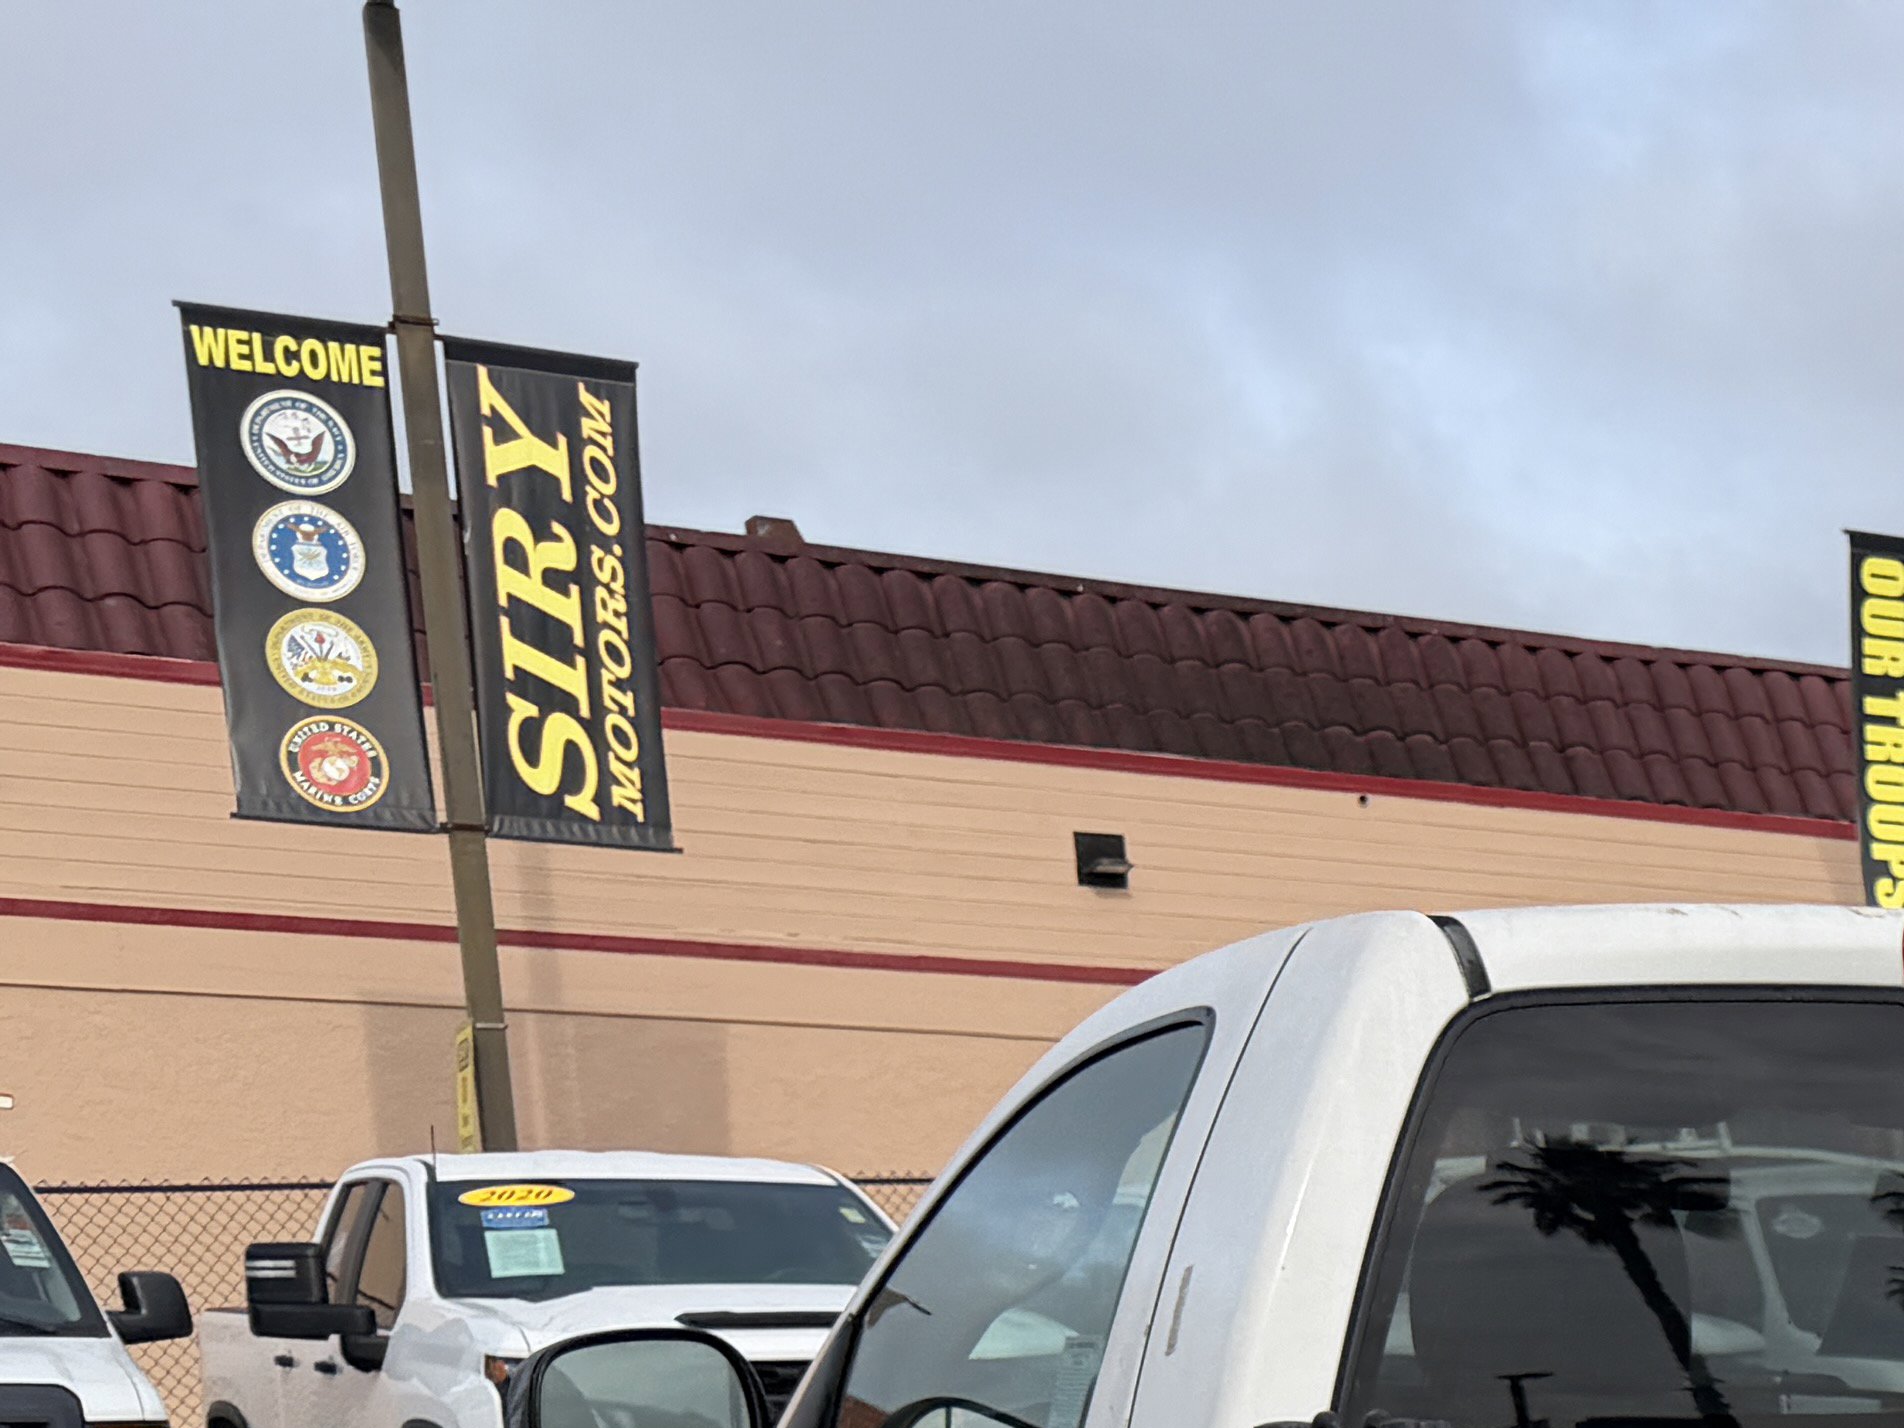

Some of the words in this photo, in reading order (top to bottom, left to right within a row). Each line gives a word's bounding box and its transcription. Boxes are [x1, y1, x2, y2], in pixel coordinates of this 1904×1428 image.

[190, 323, 384, 387] WELCOME
[477, 364, 600, 822] SIRY
[578, 382, 645, 823] MOTORS.COM
[480, 1189, 553, 1202] 2020
